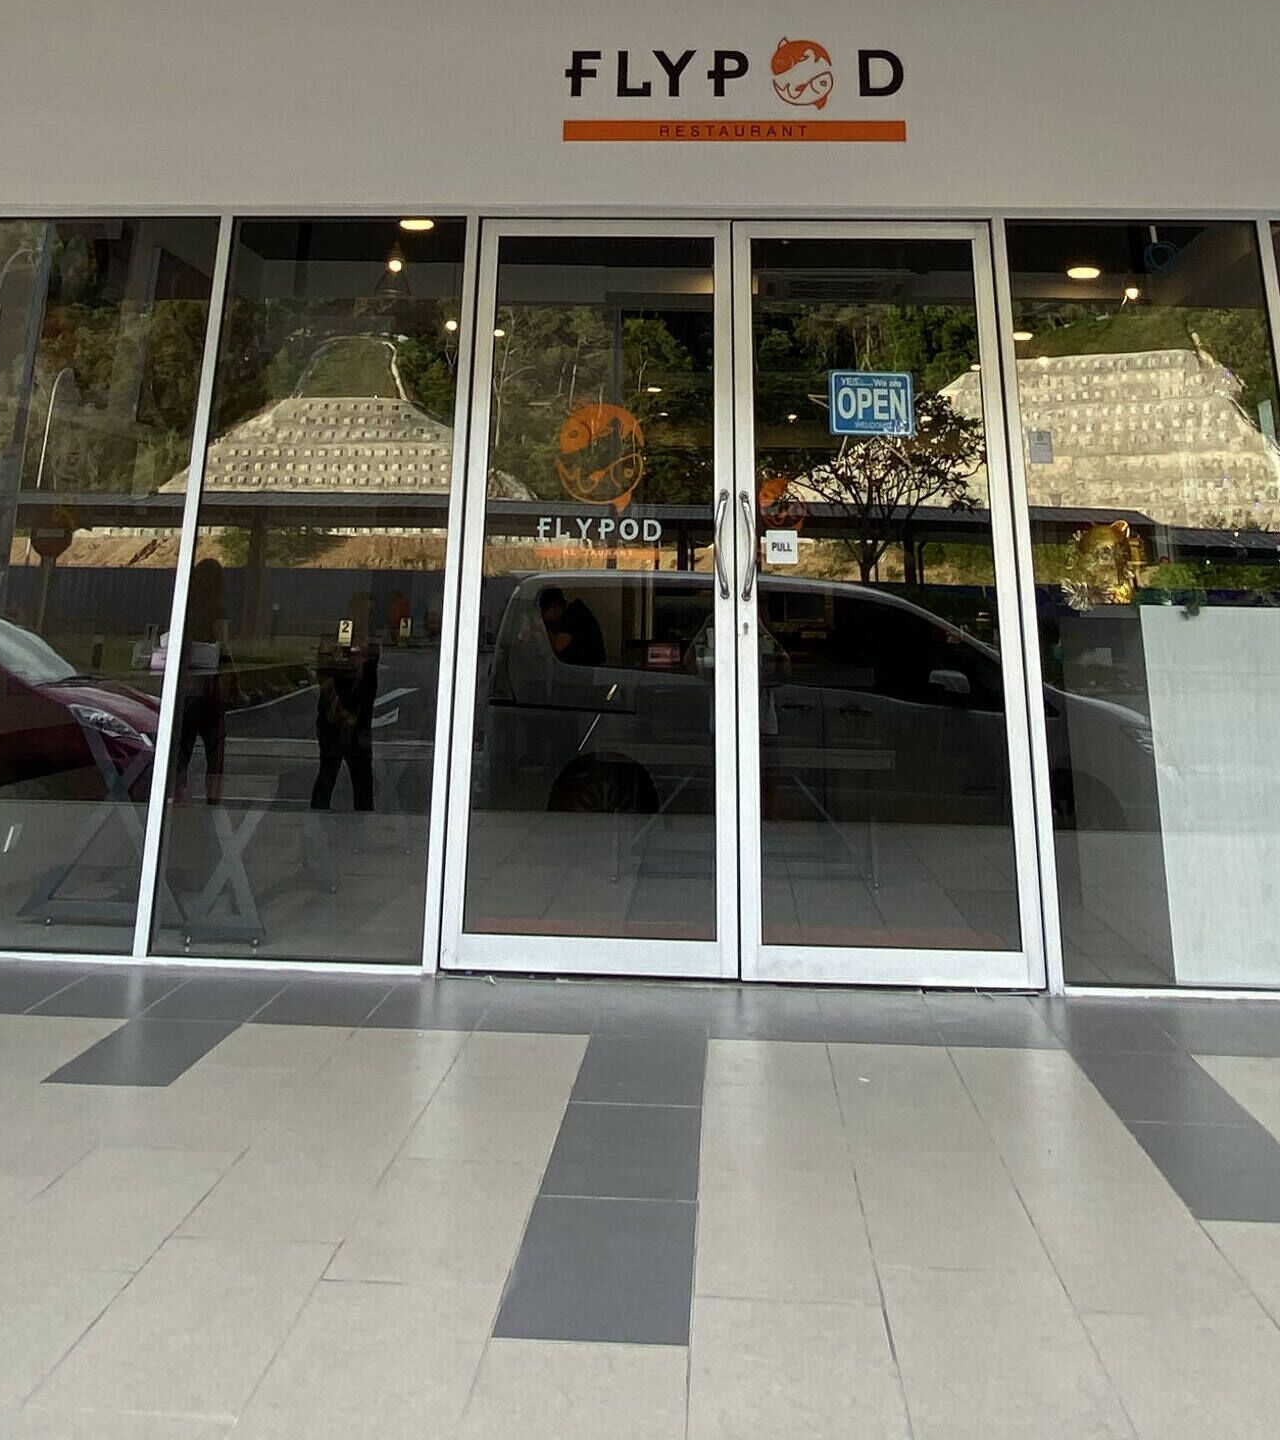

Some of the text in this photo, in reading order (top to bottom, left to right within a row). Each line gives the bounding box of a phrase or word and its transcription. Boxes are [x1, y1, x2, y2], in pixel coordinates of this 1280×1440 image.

[659, 124, 809, 138] RESTAURANT
[837, 387, 907, 421] OPEN
[536, 517, 662, 541] FLYPOD
[771, 542, 793, 552] PULL
